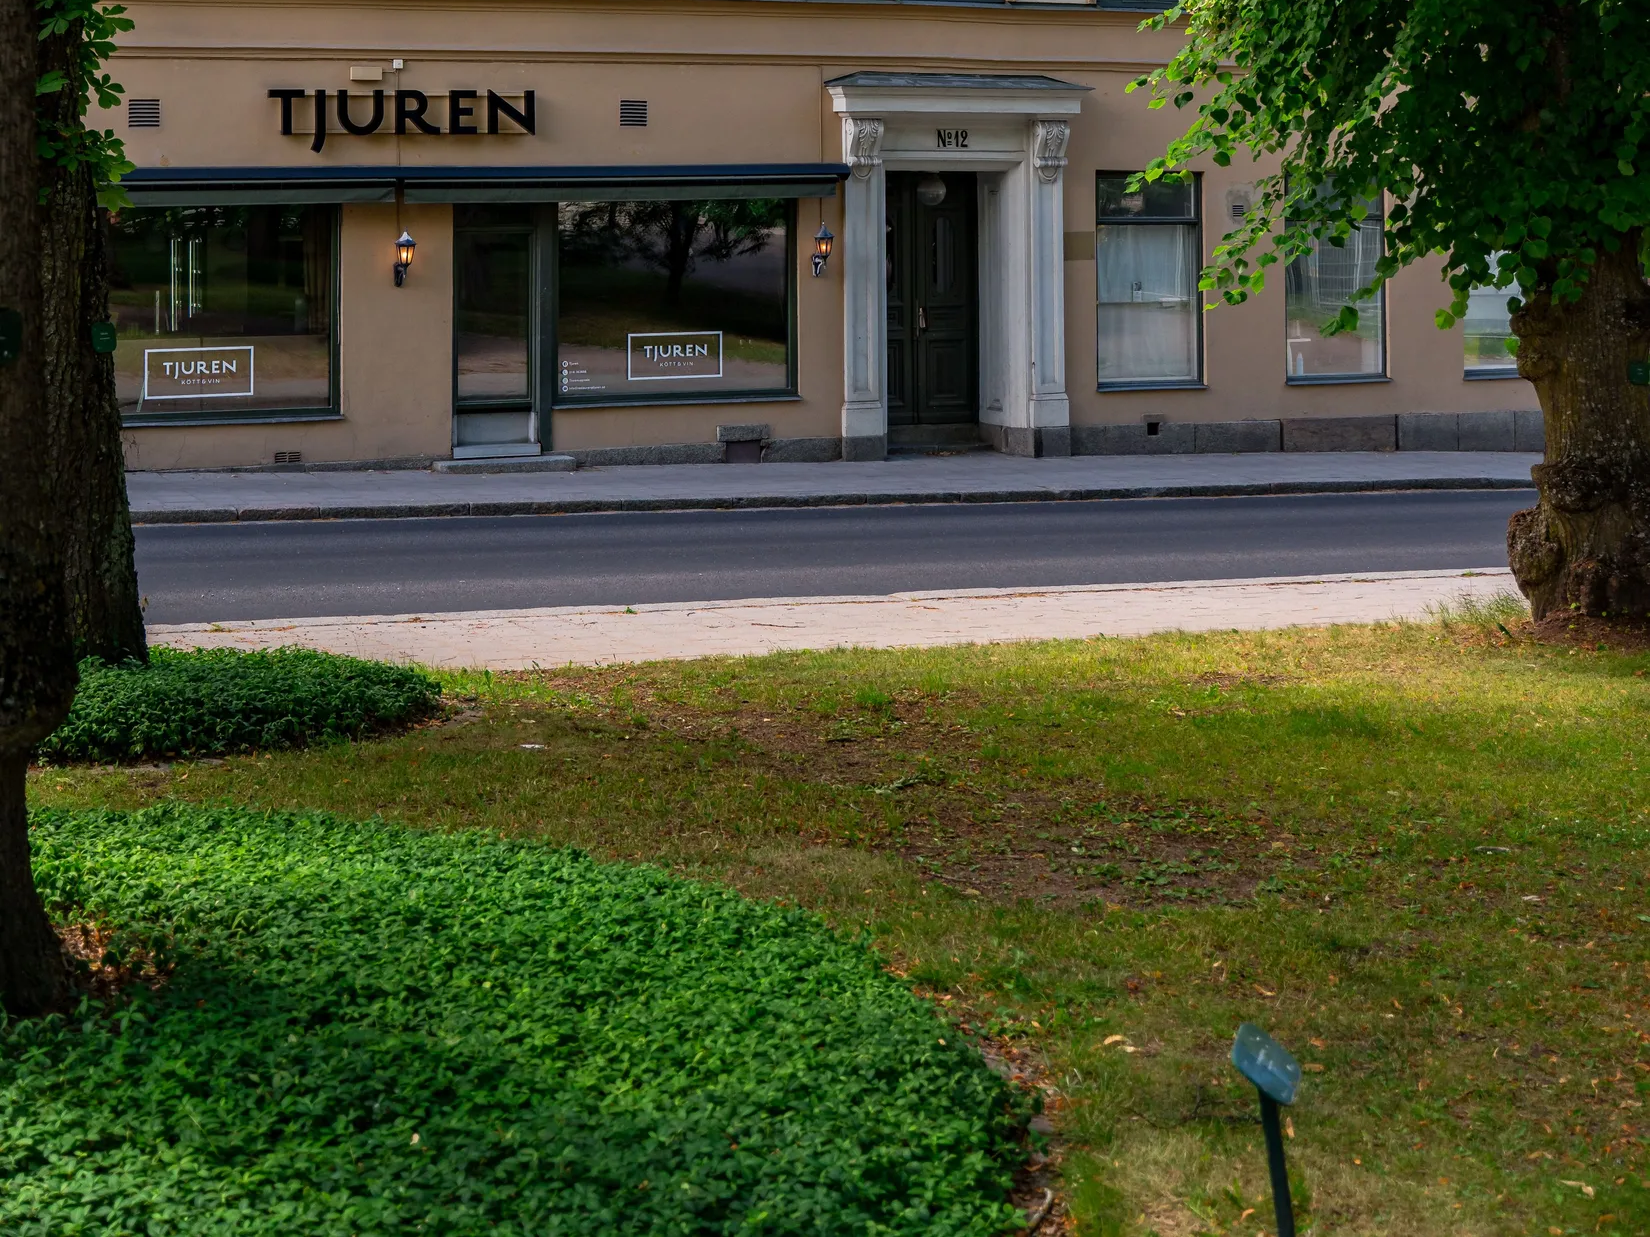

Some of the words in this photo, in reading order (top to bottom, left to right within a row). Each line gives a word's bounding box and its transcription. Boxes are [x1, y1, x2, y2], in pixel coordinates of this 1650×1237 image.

[268, 89, 535, 153] TJUREN
[643, 344, 708, 362] TJUREN
[163, 360, 237, 379] TJUREN
